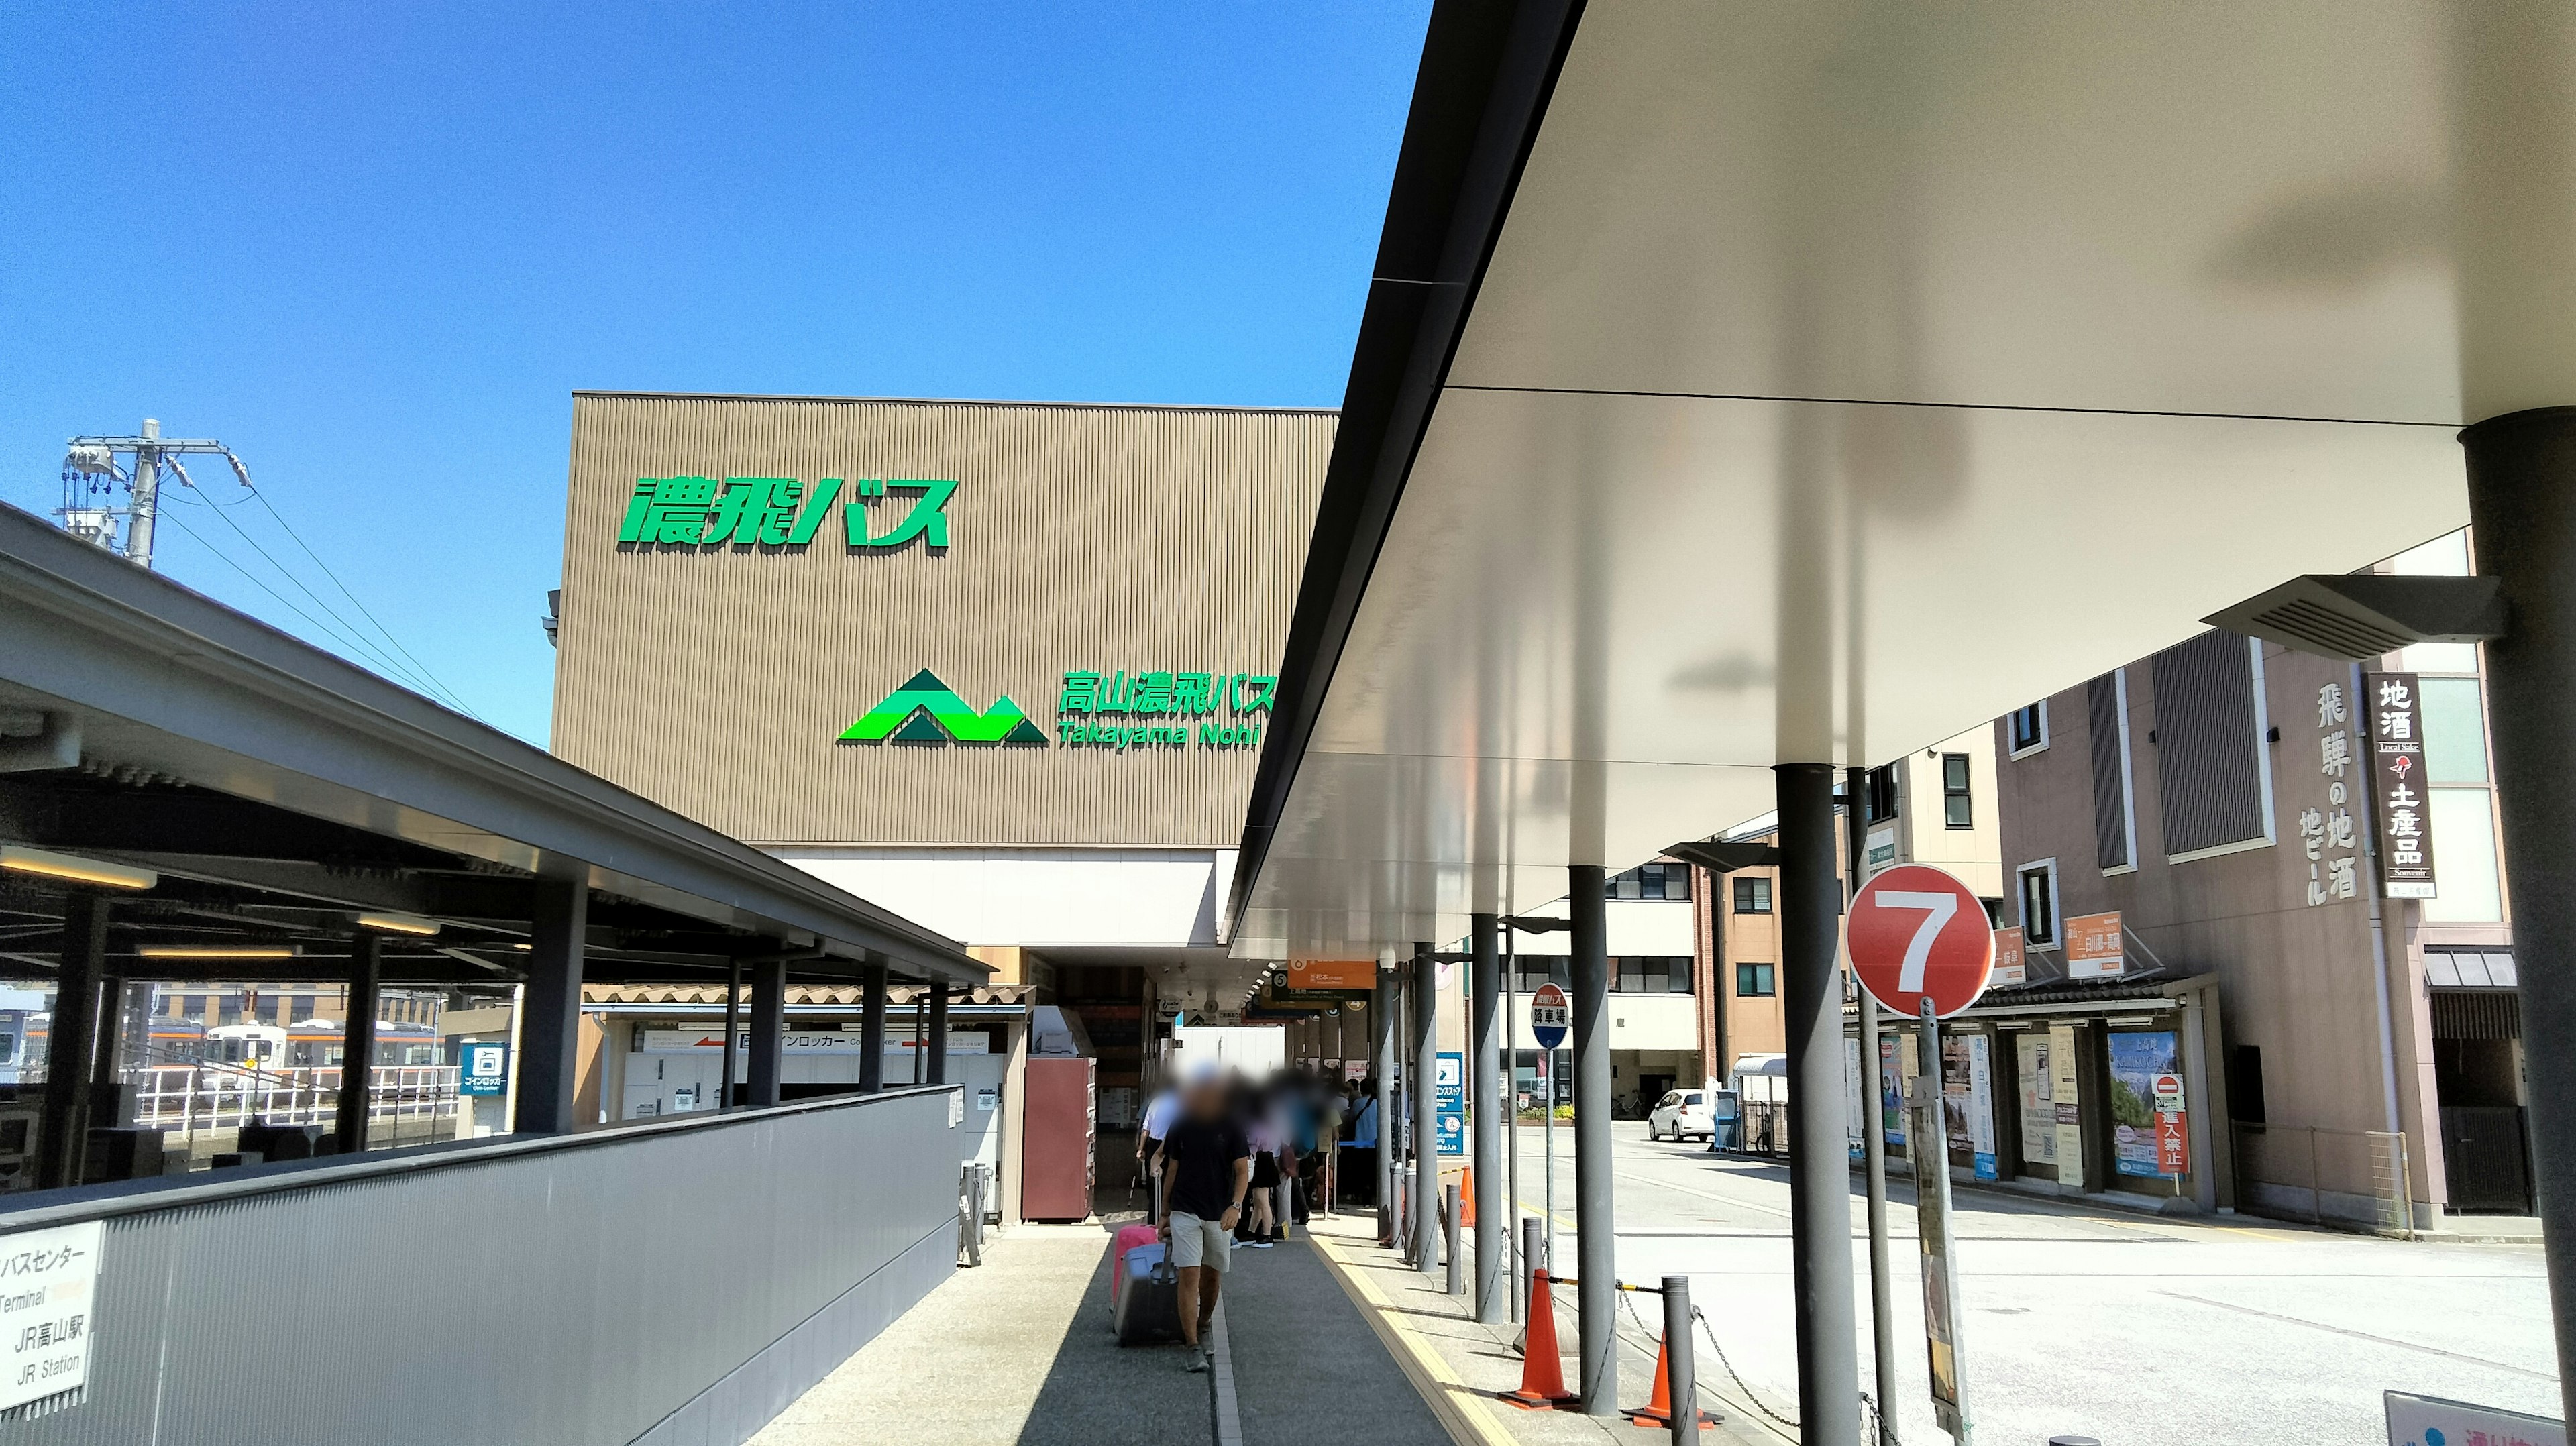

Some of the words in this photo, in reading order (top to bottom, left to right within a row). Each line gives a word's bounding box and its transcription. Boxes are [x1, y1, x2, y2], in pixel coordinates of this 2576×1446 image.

[618, 476, 960, 547] 濃飛バス
[1059, 670, 1277, 714] 高山濃飛バス
[2379, 679, 2412, 740] 地酒
[1058, 721, 1188, 748] Takayama
[1198, 722, 1262, 746] Nohi
[2380, 743, 2400, 751] Local
[2401, 743, 2420, 752] Sake
[2318, 683, 2357, 899] 飛騨の地酒
[2388, 783, 2423, 865] 土産品
[2299, 807, 2328, 907] 地ビール
[2394, 868, 2427, 877] Souvenir
[1874, 890, 1958, 993] 7
[1277, 975, 1284, 985] 5
[1534, 1008, 1566, 1025] 降車場
[782, 1036, 845, 1047] ンロッカー
[464, 1077, 508, 1086] コインロッカー
[2162, 1112, 2182, 1166] 進入禁止
[0, 1245, 85, 1276] バスセンター
[15, 1314, 85, 1353] JR高山駅
[17, 1364, 36, 1386] JR
[41, 1355, 80, 1379] Station
